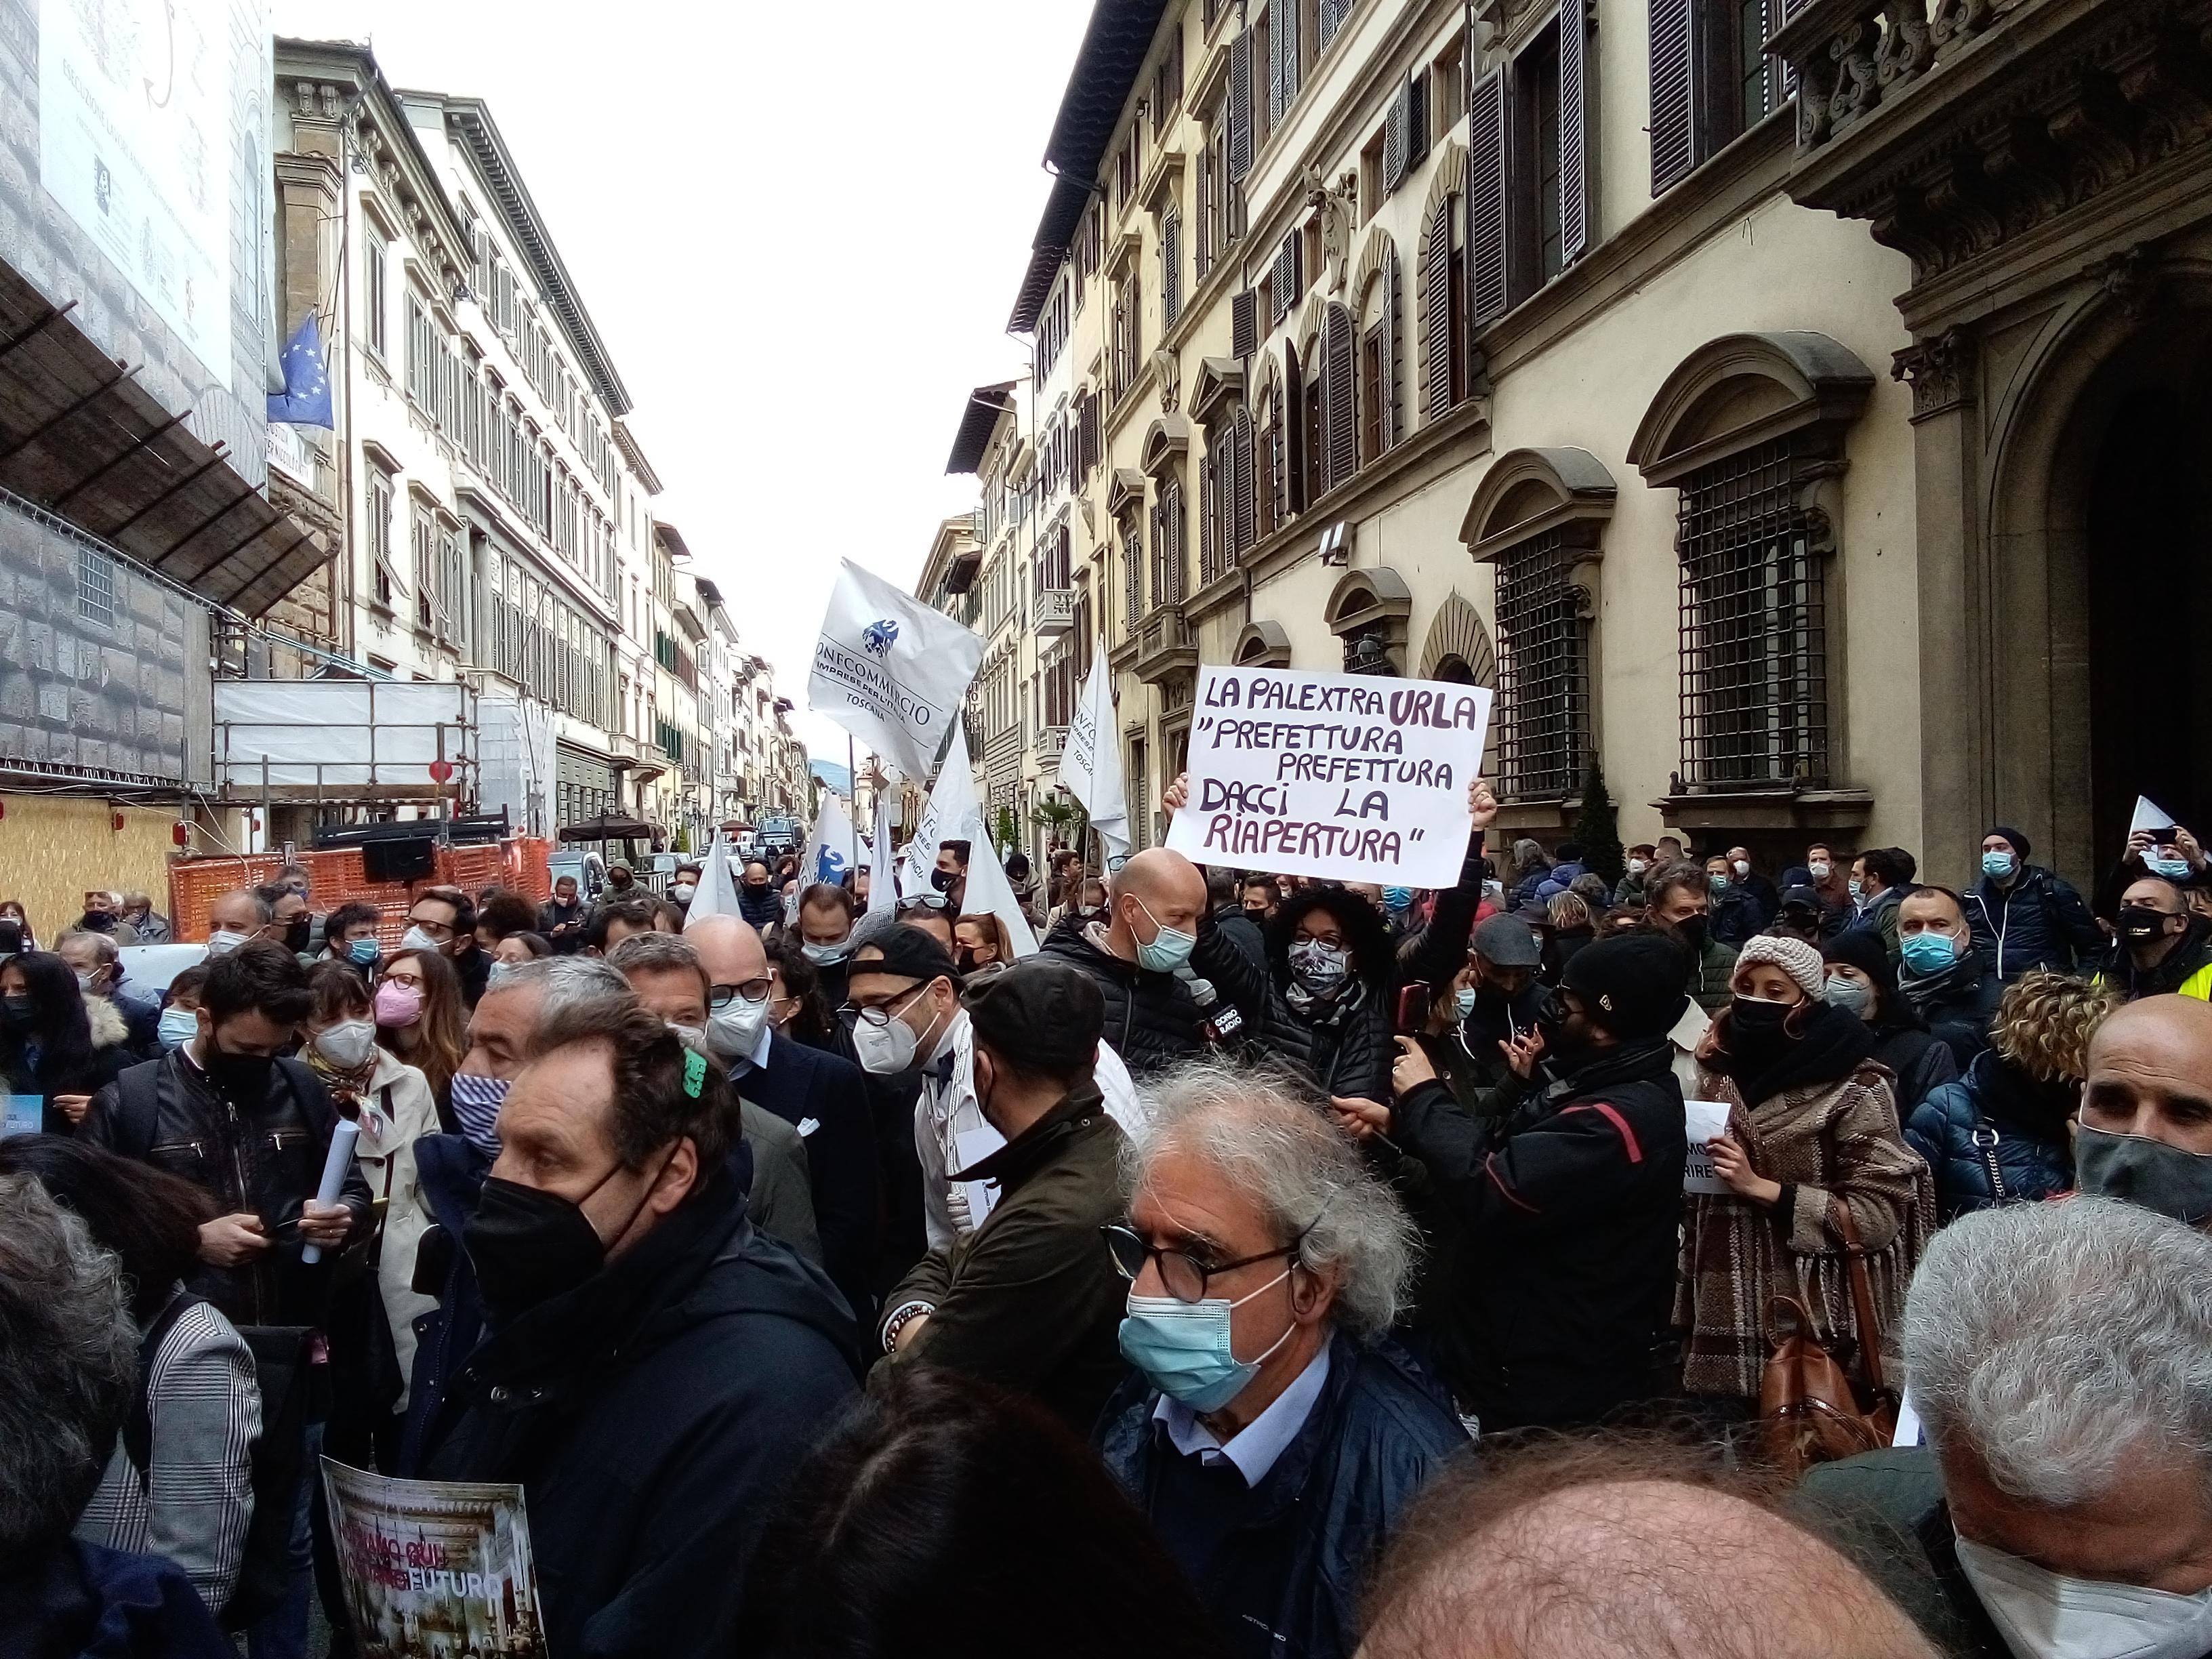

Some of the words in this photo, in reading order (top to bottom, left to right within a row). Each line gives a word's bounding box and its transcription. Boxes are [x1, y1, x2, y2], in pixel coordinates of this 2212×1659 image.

[817, 661, 861, 687] IMPRESE
[863, 684, 879, 699] PER
[1204, 677, 1240, 708] LA
[1246, 678, 1385, 715] PALEXTRA
[1389, 689, 1477, 731] URLA
[1275, 753, 1452, 790] PREFETTURA
[1334, 787, 1389, 821] LA
[1219, 1017, 1242, 1034] RADIO
